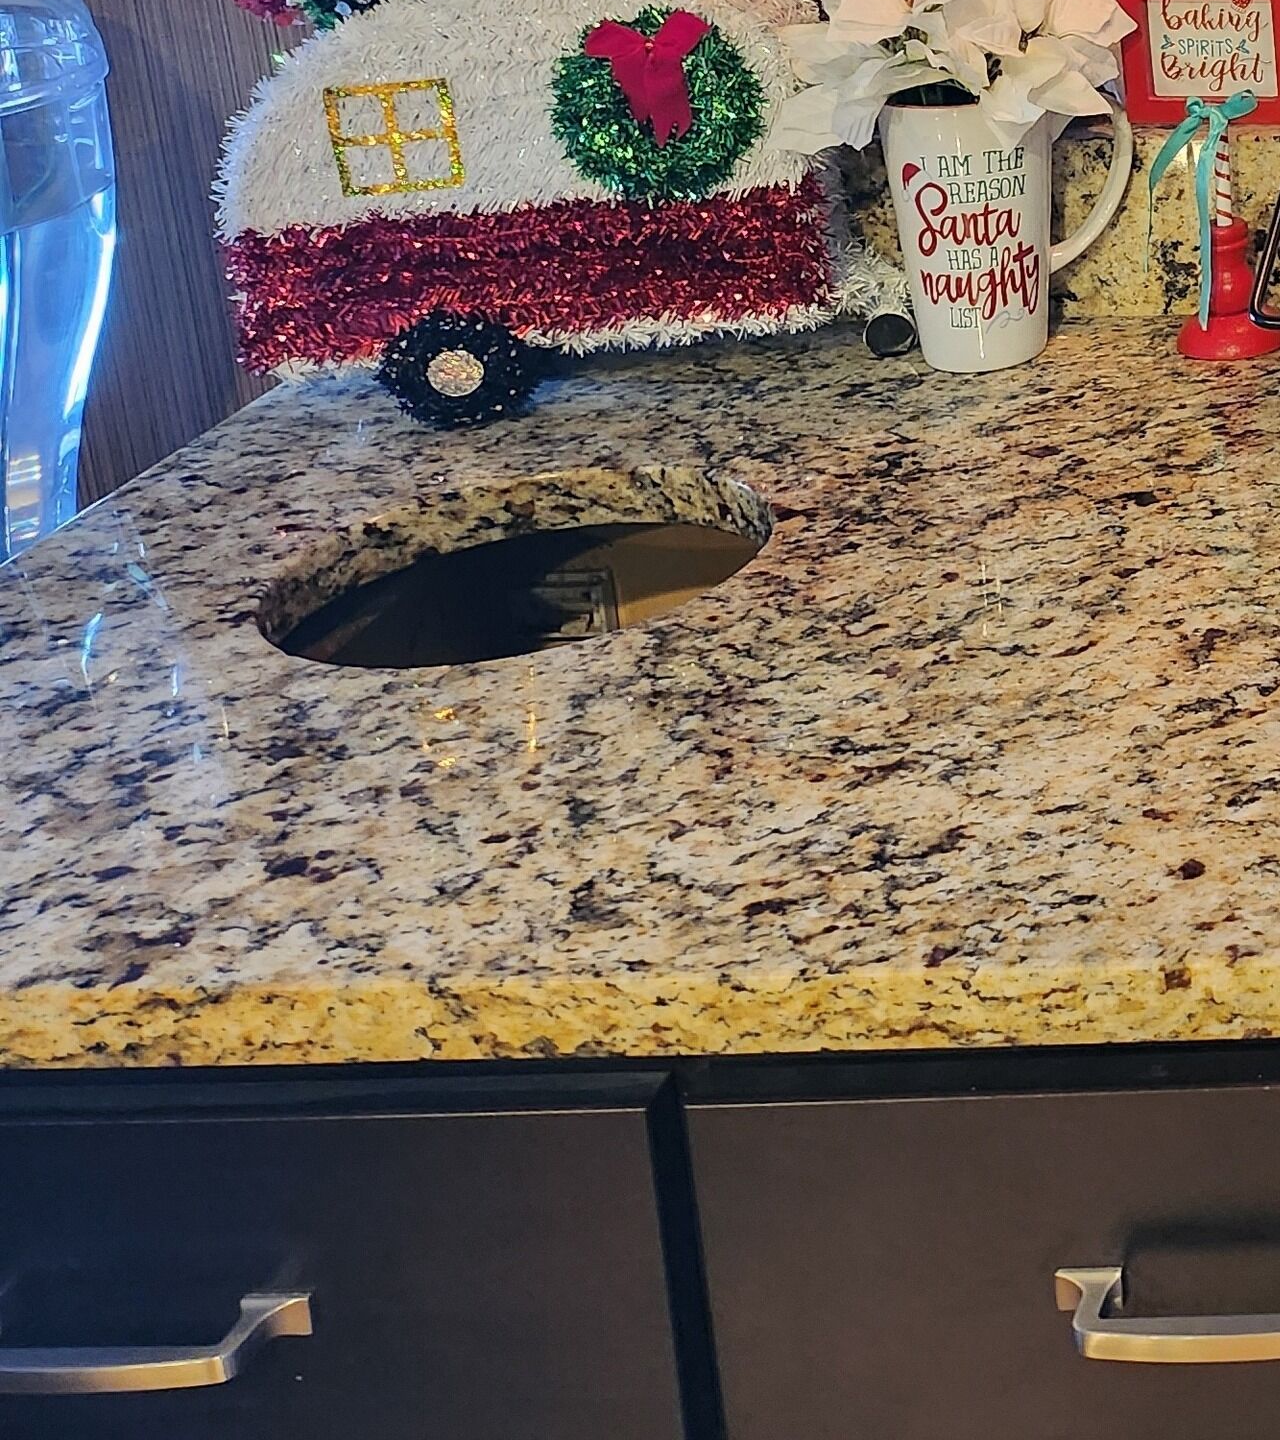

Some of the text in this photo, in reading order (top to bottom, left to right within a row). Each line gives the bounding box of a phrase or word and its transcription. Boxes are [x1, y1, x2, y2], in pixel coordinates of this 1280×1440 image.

[1161, 52, 1271, 92] Bright
[937, 155, 973, 178] AM
[983, 147, 1025, 173] THE
[946, 174, 1027, 205] REASON
[914, 182, 1021, 257] Santa
[946, 246, 999, 271] HAS A
[920, 241, 1040, 320] naughty
[950, 306, 982, 329] LIST
